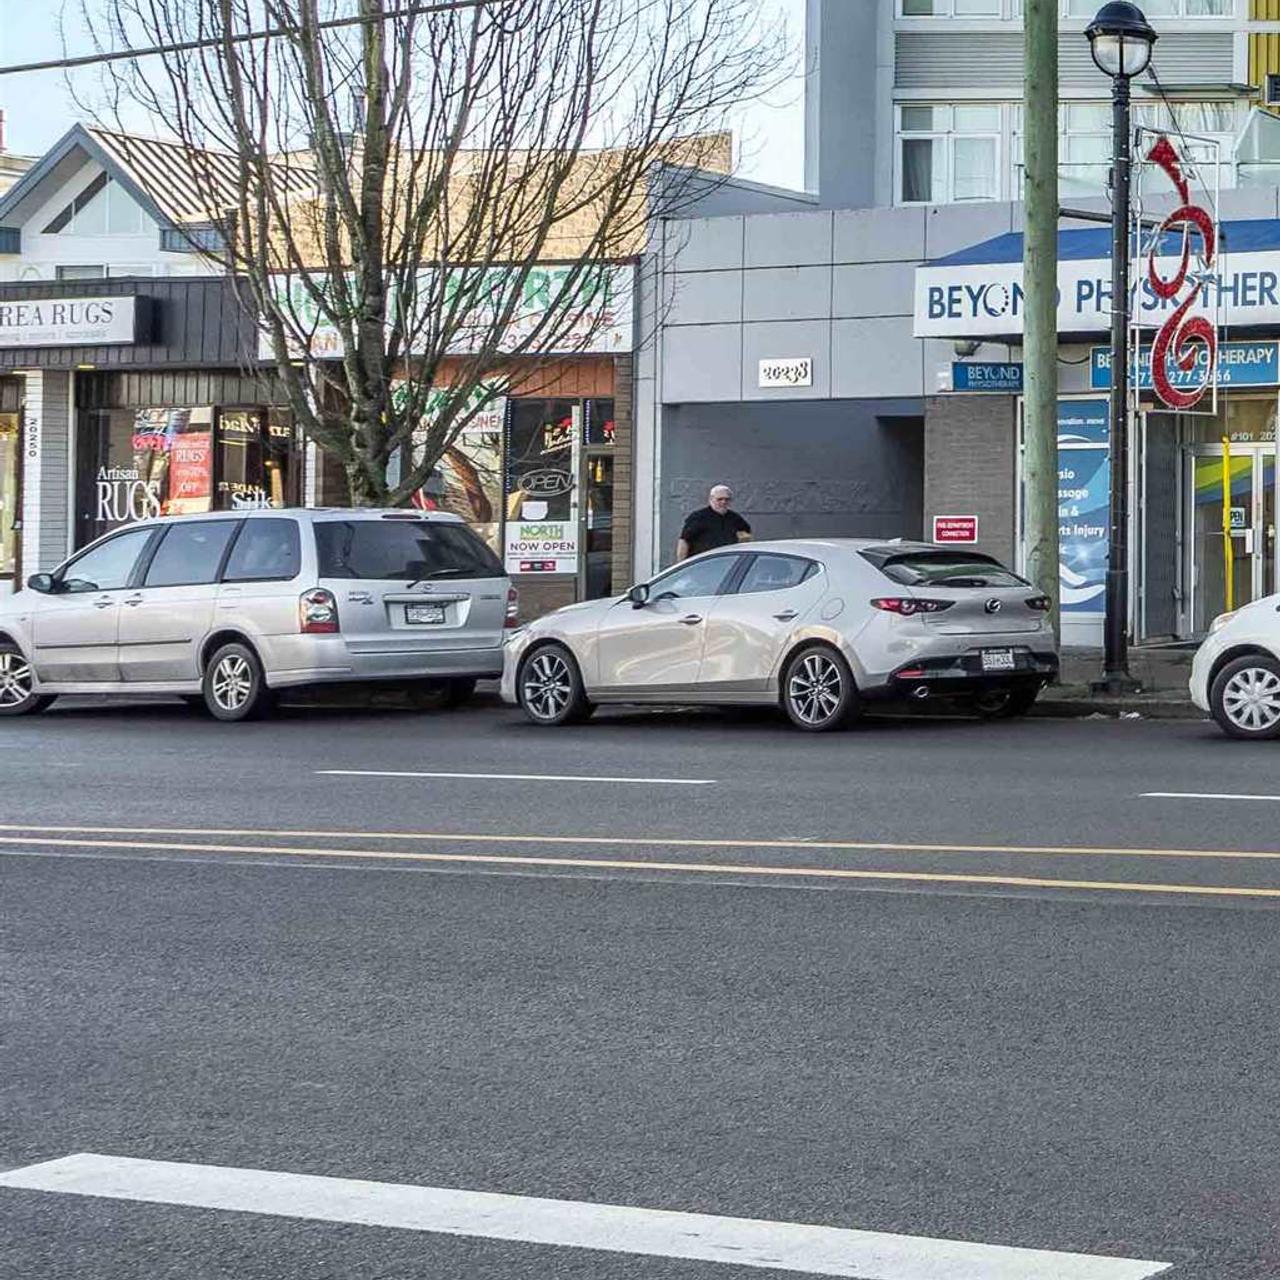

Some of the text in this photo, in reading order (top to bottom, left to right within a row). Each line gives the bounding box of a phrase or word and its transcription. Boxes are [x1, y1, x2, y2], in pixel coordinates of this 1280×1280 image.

[928, 282, 1061, 319] BEYO
[52, 301, 114, 325] RUGS
[1097, 347, 1274, 369] BEND HIOHERAPY
[967, 366, 1020, 380] BEYOND
[176, 450, 206, 462] RUGS
[97, 466, 140, 480] Artisan
[527, 474, 574, 490] OPEN
[96, 480, 162, 521] RUGS
[1058, 489, 1089, 500] ssage
[520, 524, 563, 539] NORTH
[1074, 524, 1104, 538] Injury
[510, 541, 575, 551] NOW OPEN
